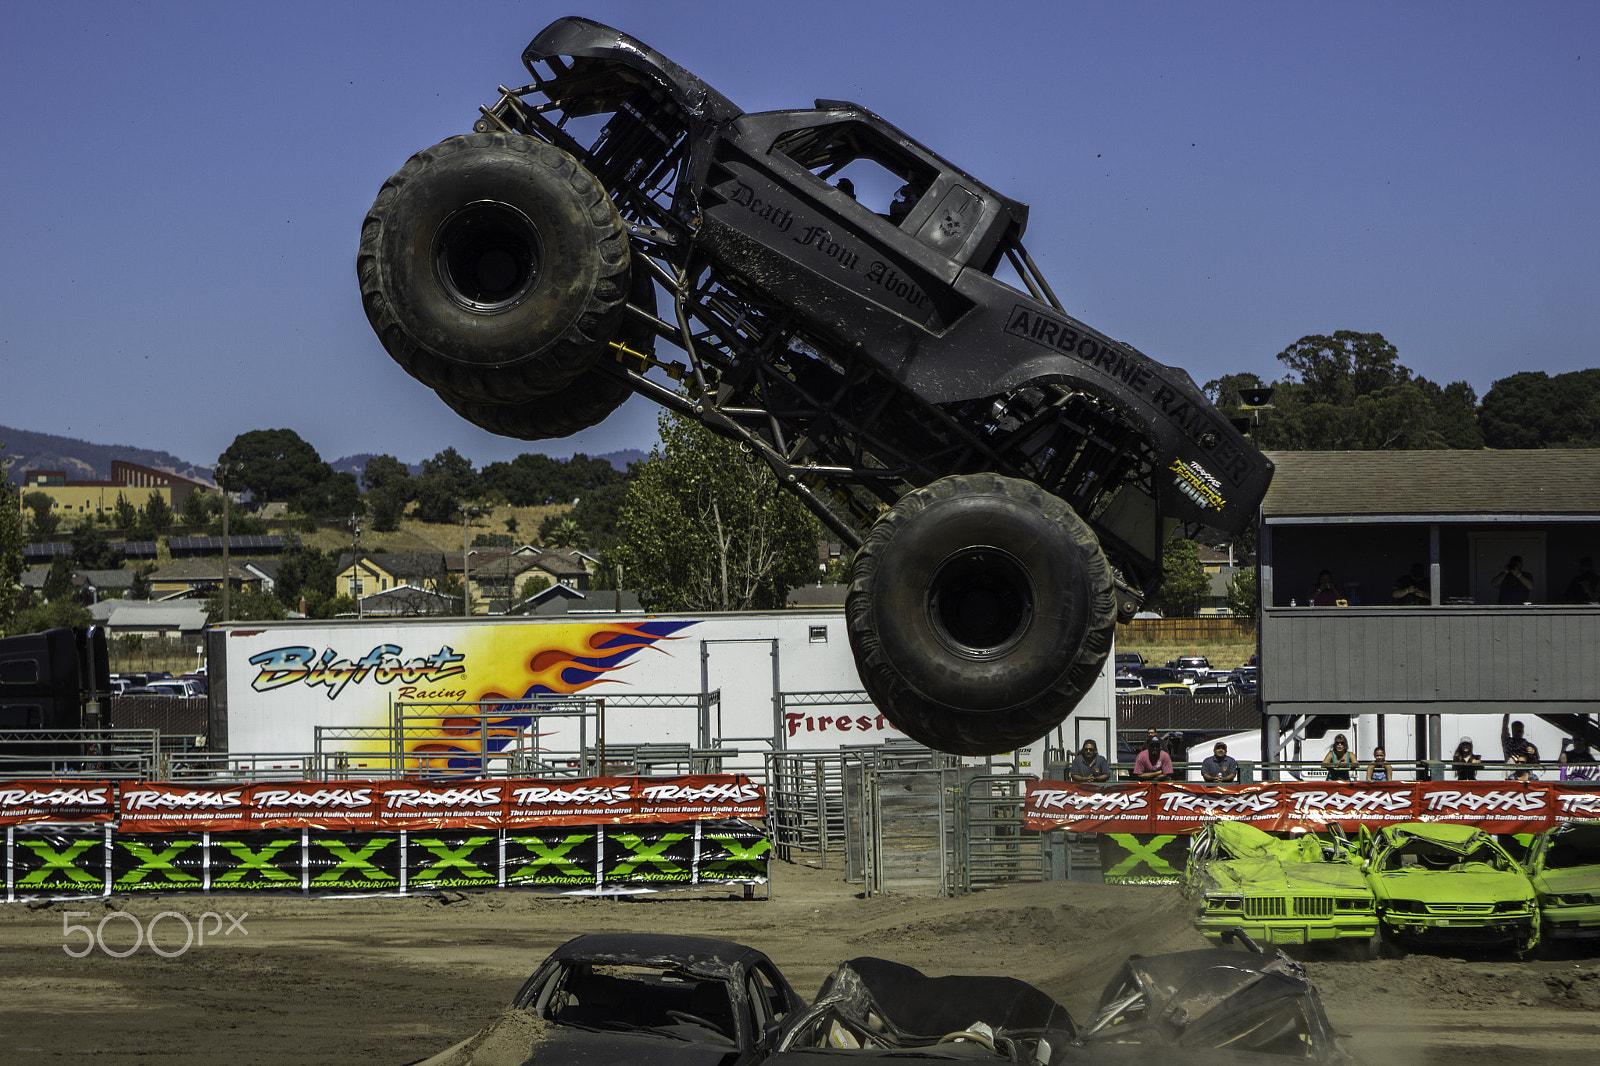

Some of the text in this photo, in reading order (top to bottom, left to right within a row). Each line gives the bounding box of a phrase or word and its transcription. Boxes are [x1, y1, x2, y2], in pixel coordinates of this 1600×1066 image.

[729, 181, 931, 310] Death From Above
[1010, 310, 1153, 394] AIRBORNE
[1190, 460, 1222, 488] TRAXXAS
[1173, 474, 1209, 510] TOUR
[248, 644, 466, 700] Bigfoot
[398, 686, 467, 701] Racing
[123, 791, 242, 810] TRAXXAS
[253, 789, 372, 809] TRAXXAS
[383, 787, 503, 809] TRAXXAS
[512, 786, 631, 806] TRAXXAS
[642, 784, 760, 804] TRAXXAS
[1030, 791, 1149, 811] TRAXXAS
[1159, 791, 1279, 812] TRAXXAS
[1290, 791, 1412, 811] TRAXXAS
[1424, 791, 1547, 811] TRAXXAS
